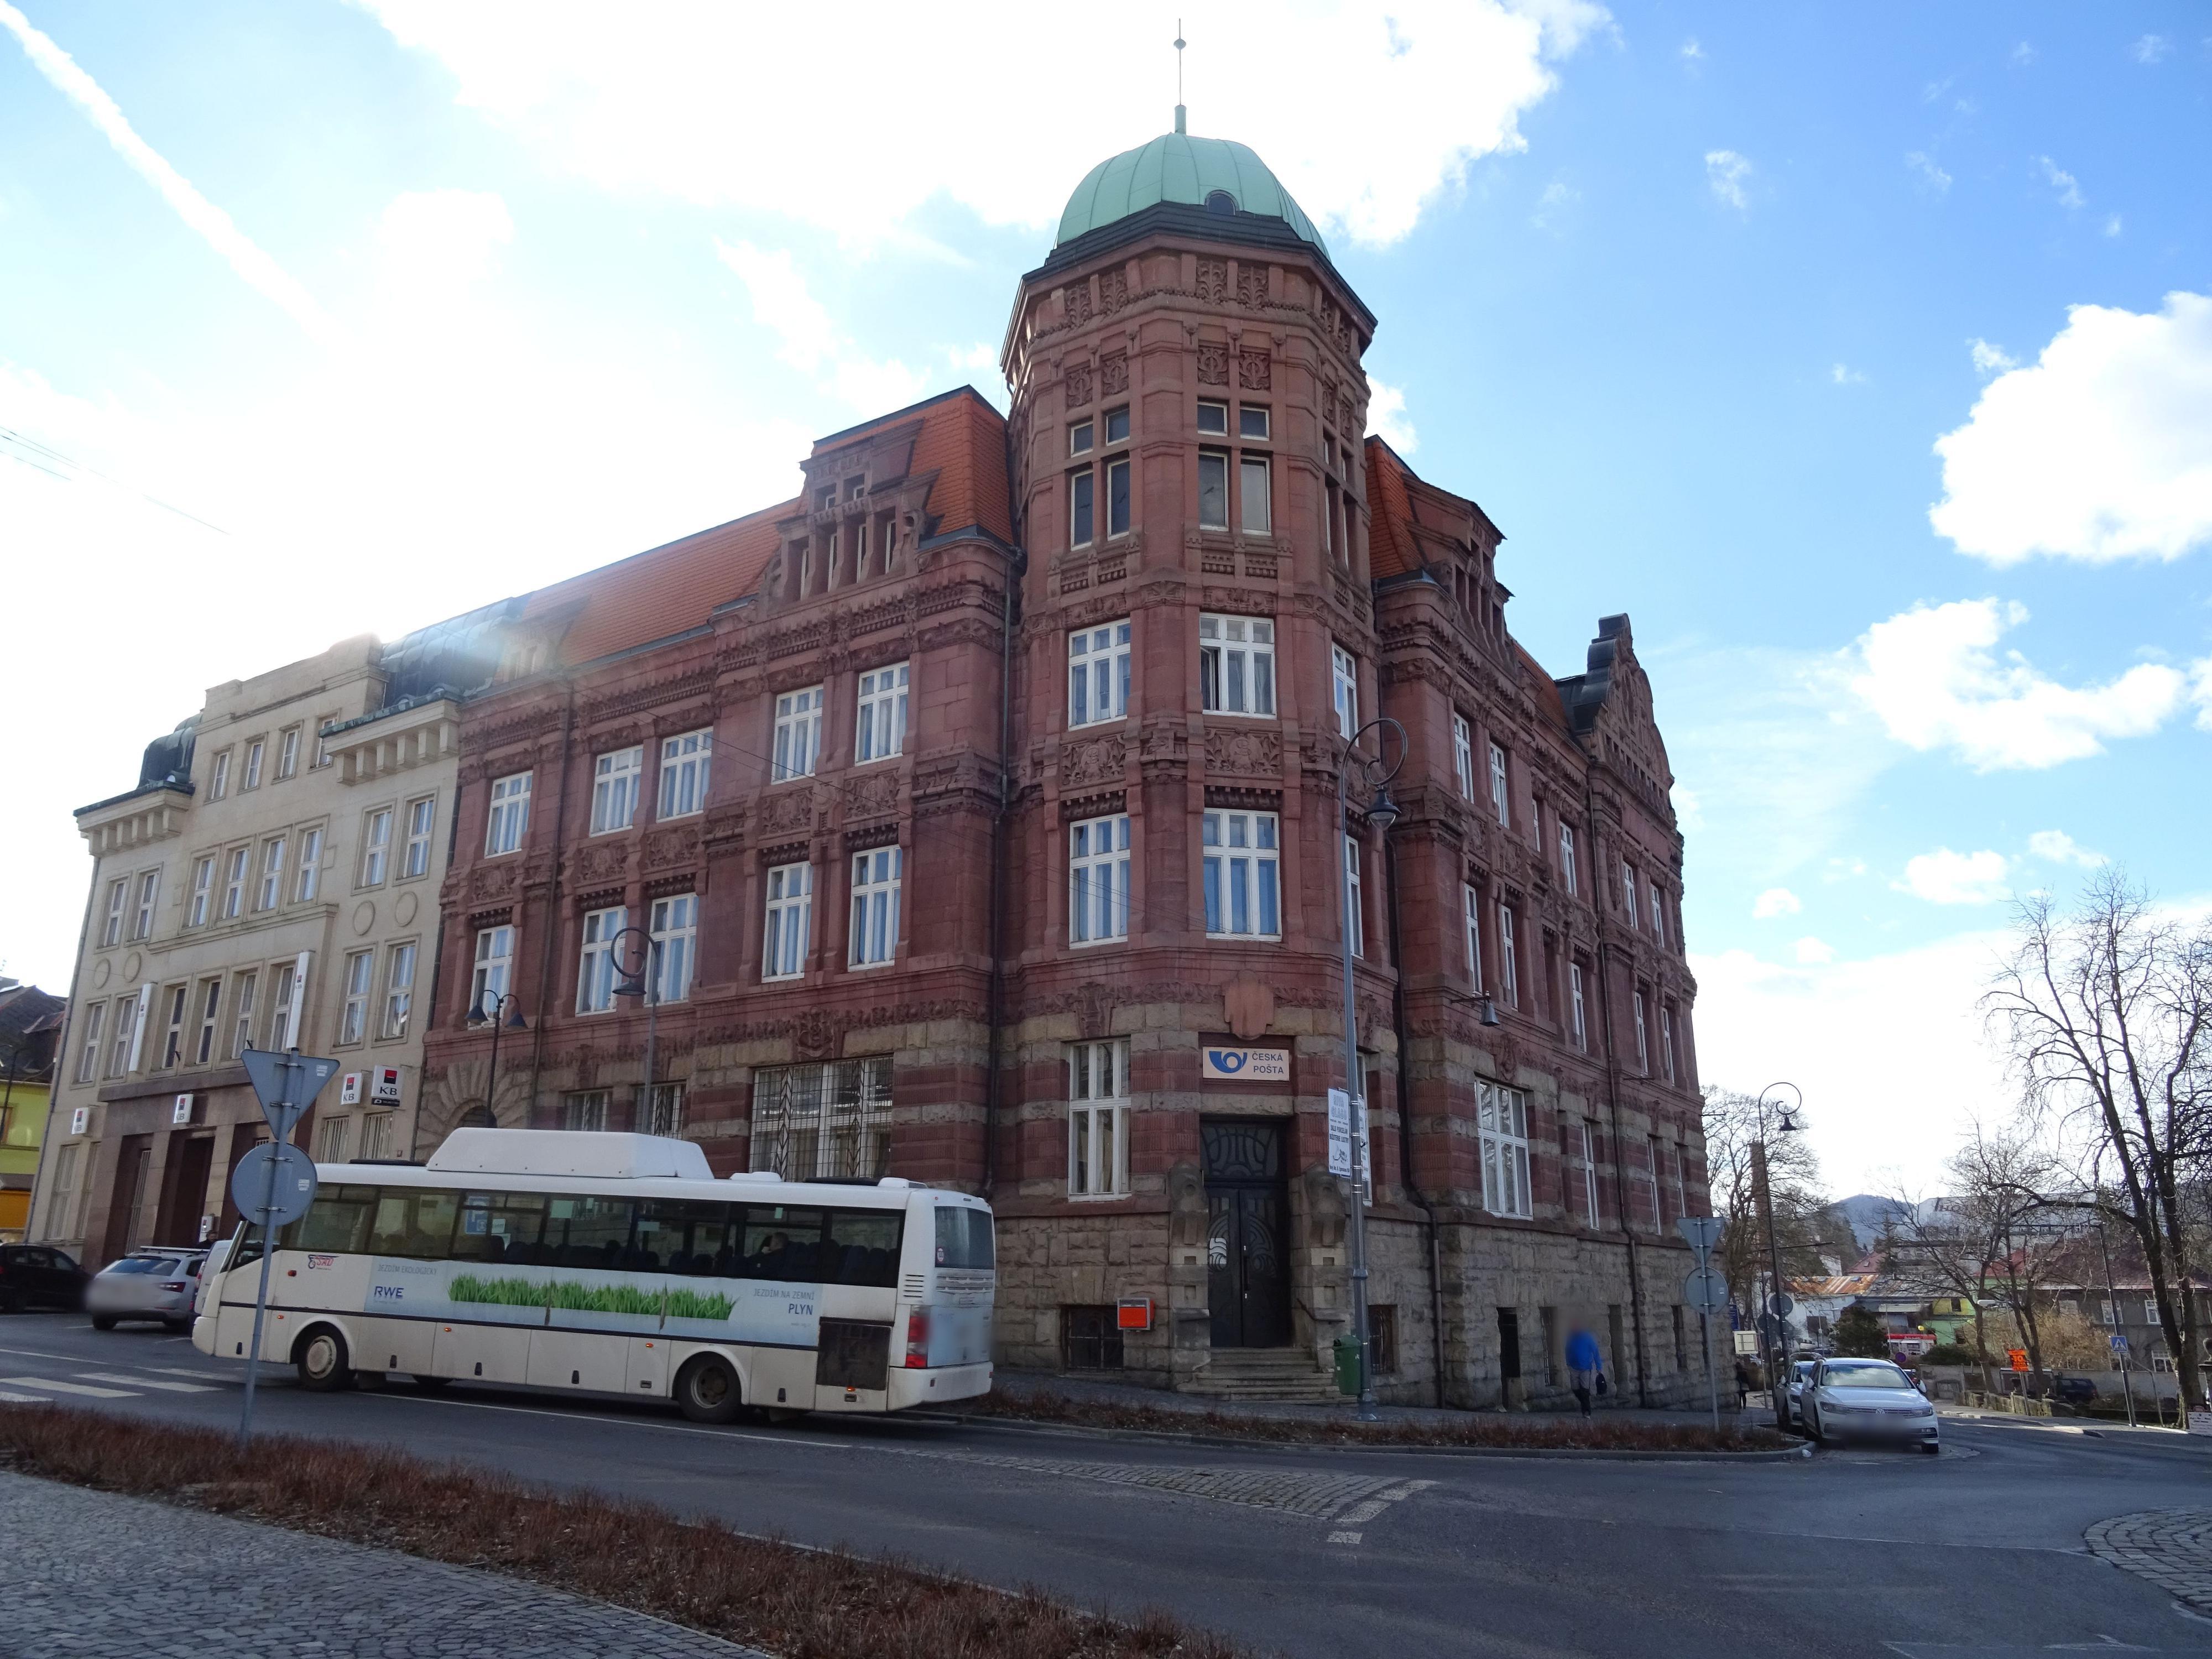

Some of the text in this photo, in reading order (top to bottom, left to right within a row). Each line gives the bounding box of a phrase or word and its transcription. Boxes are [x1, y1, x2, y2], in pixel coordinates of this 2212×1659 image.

[1252, 1051, 1283, 1061] ČESKÁ
[1253, 1064, 1284, 1074] POŠTA
[380, 1087, 397, 1095] KB
[343, 1093, 354, 1102] KB
[374, 1286, 404, 1297] RWE
[788, 1303, 813, 1315] PLYN
